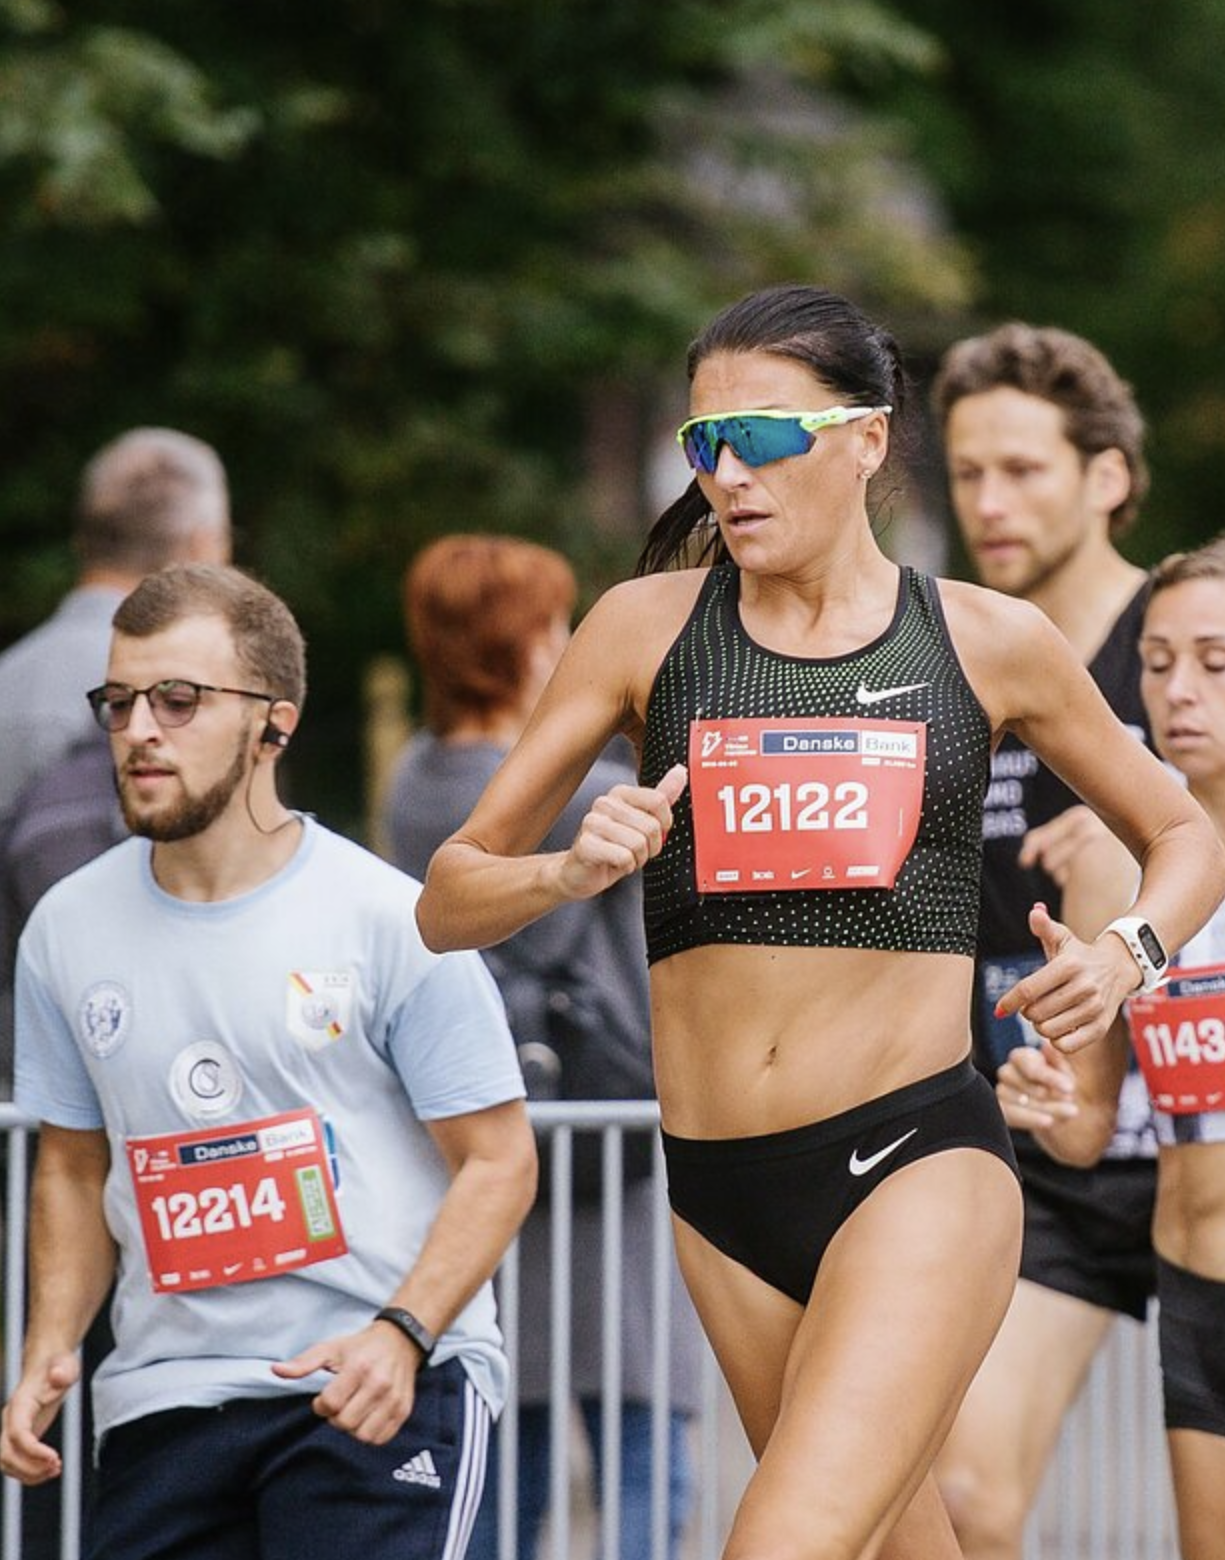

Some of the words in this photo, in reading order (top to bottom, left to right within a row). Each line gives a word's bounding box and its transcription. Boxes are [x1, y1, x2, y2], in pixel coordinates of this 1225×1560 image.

[783, 735, 855, 751] Danske
[865, 737, 911, 752] Bank
[718, 782, 869, 833] 12122
[194, 1138, 257, 1161] Danske
[152, 1177, 286, 1241] 12214
